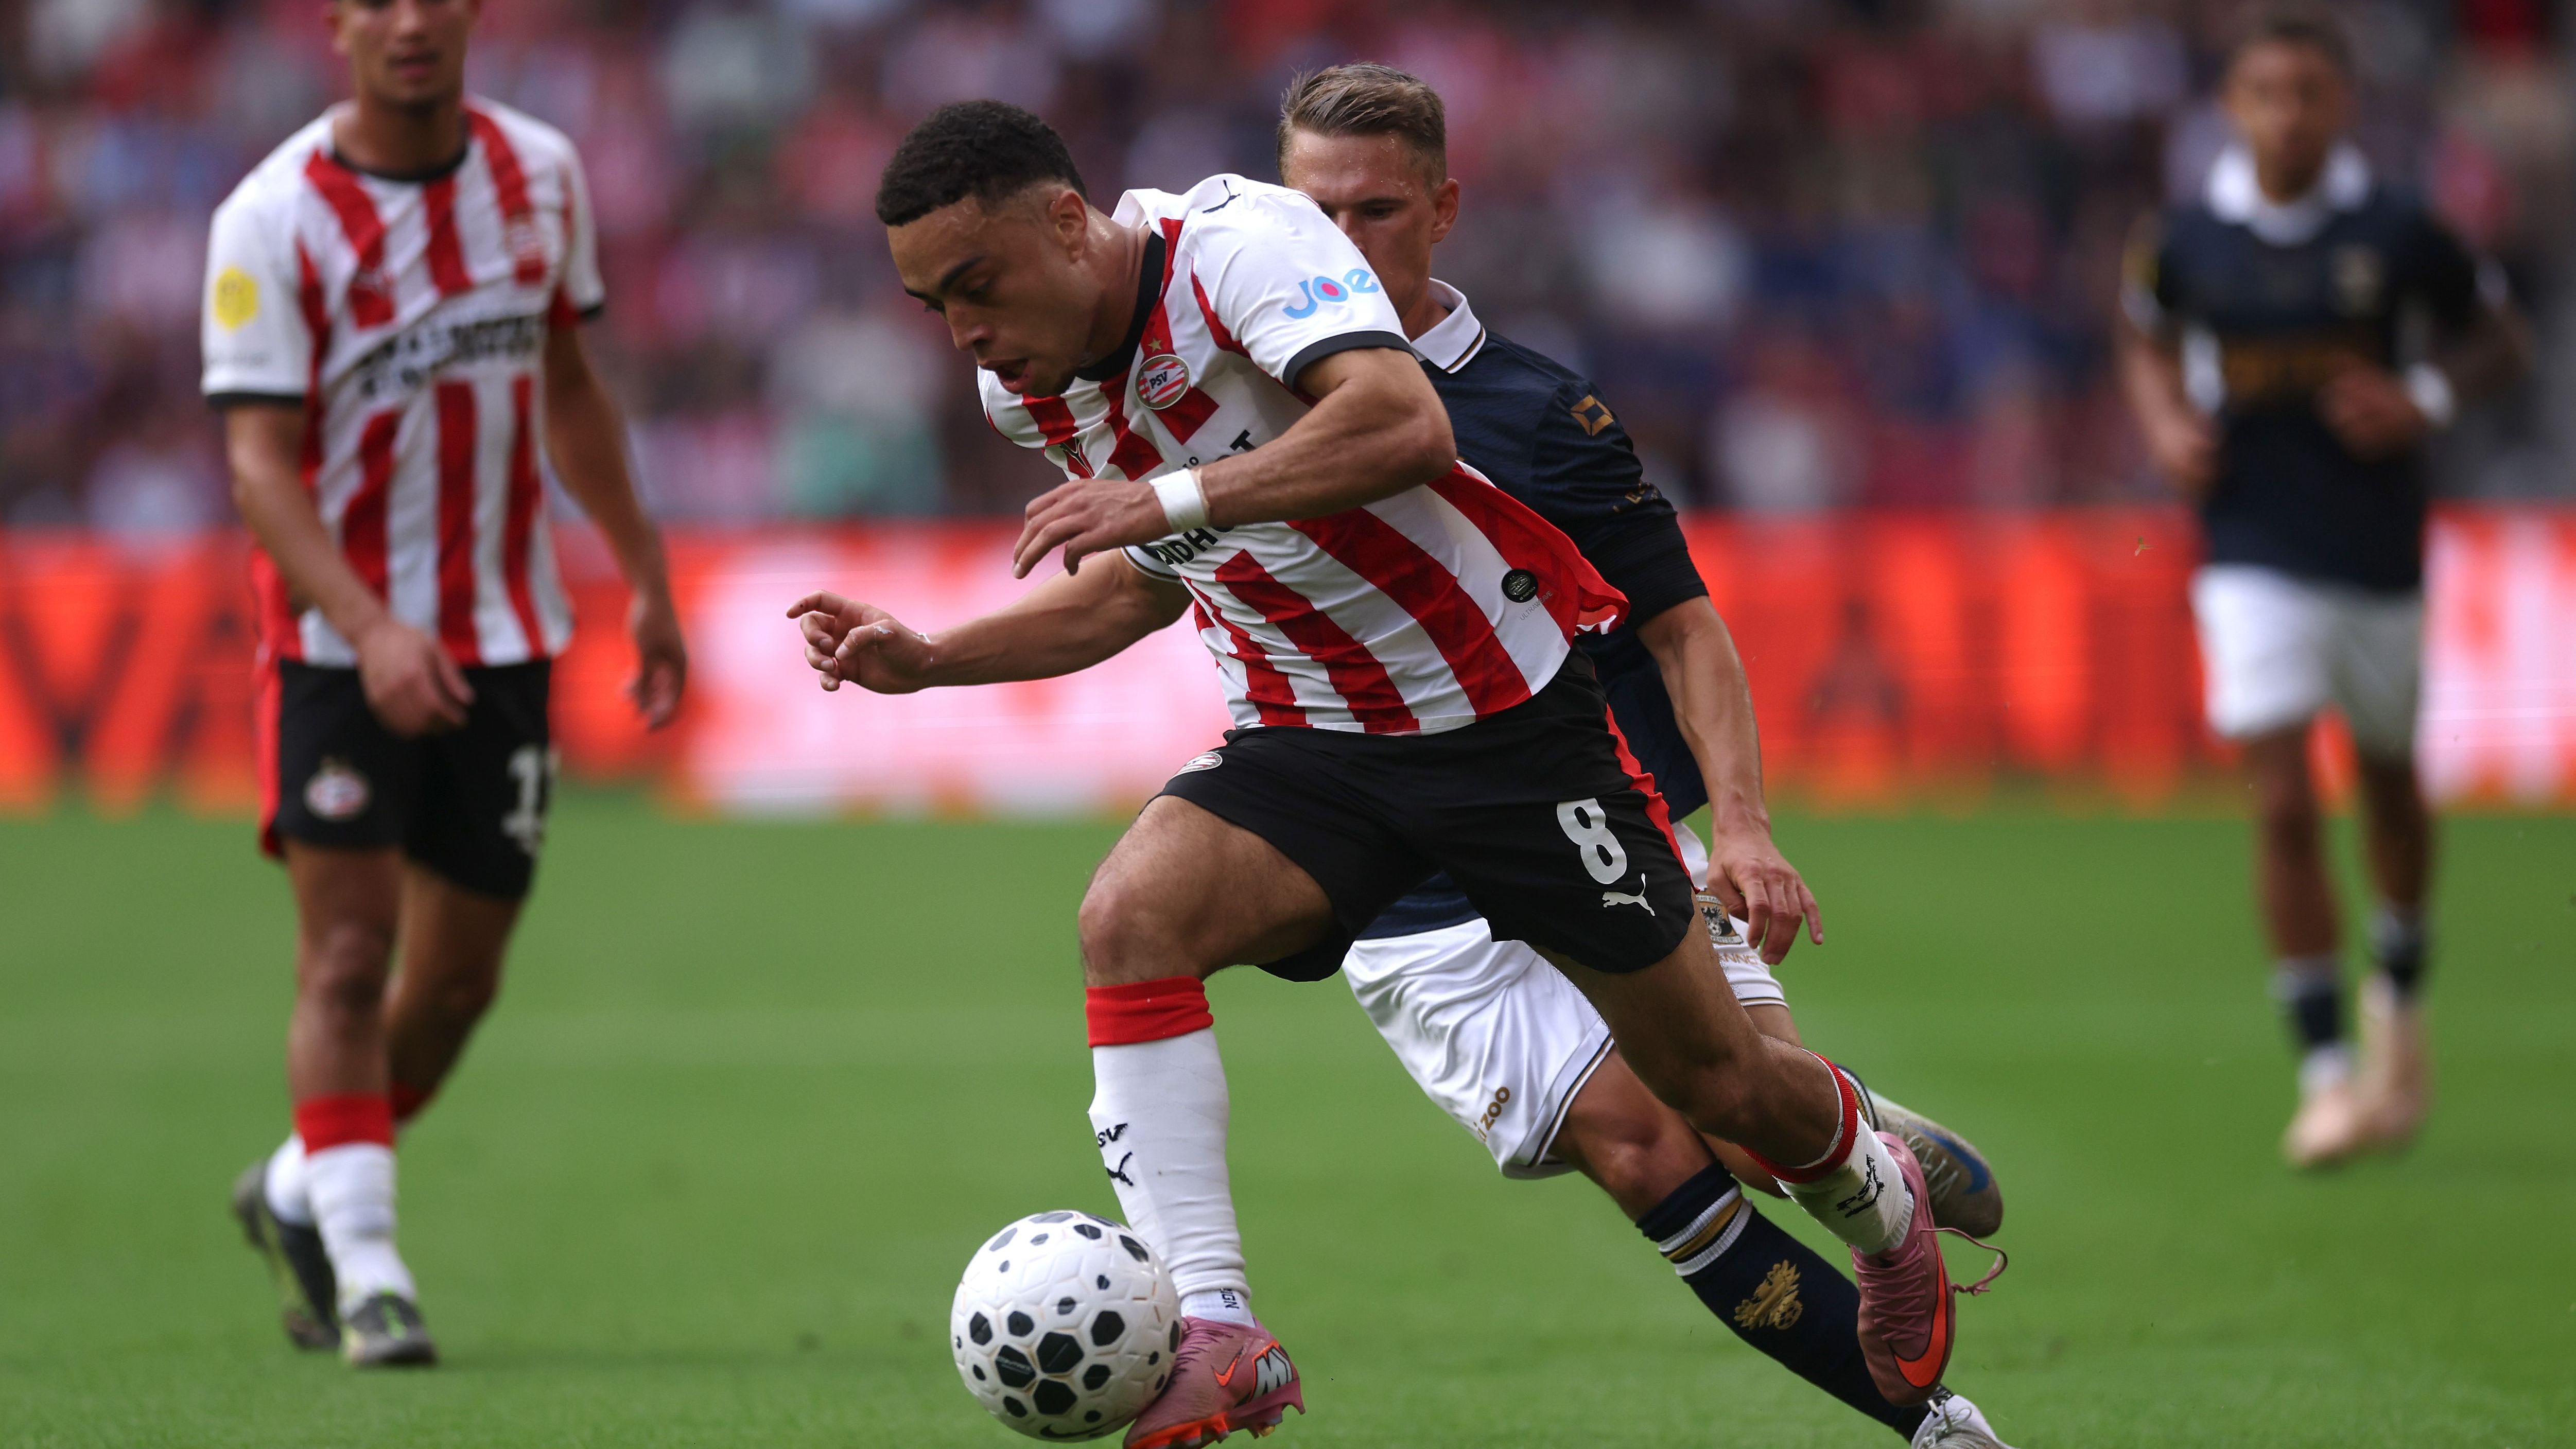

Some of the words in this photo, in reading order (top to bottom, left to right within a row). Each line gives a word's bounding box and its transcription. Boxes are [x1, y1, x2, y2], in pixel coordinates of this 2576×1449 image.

[1149, 371, 1167, 389] PSV
[1520, 591, 1553, 621] ULTRAWEAVE
[1557, 797, 1627, 884] 8
[1098, 1123, 1128, 1148] SV
[1220, 1288, 1240, 1309] IGN
